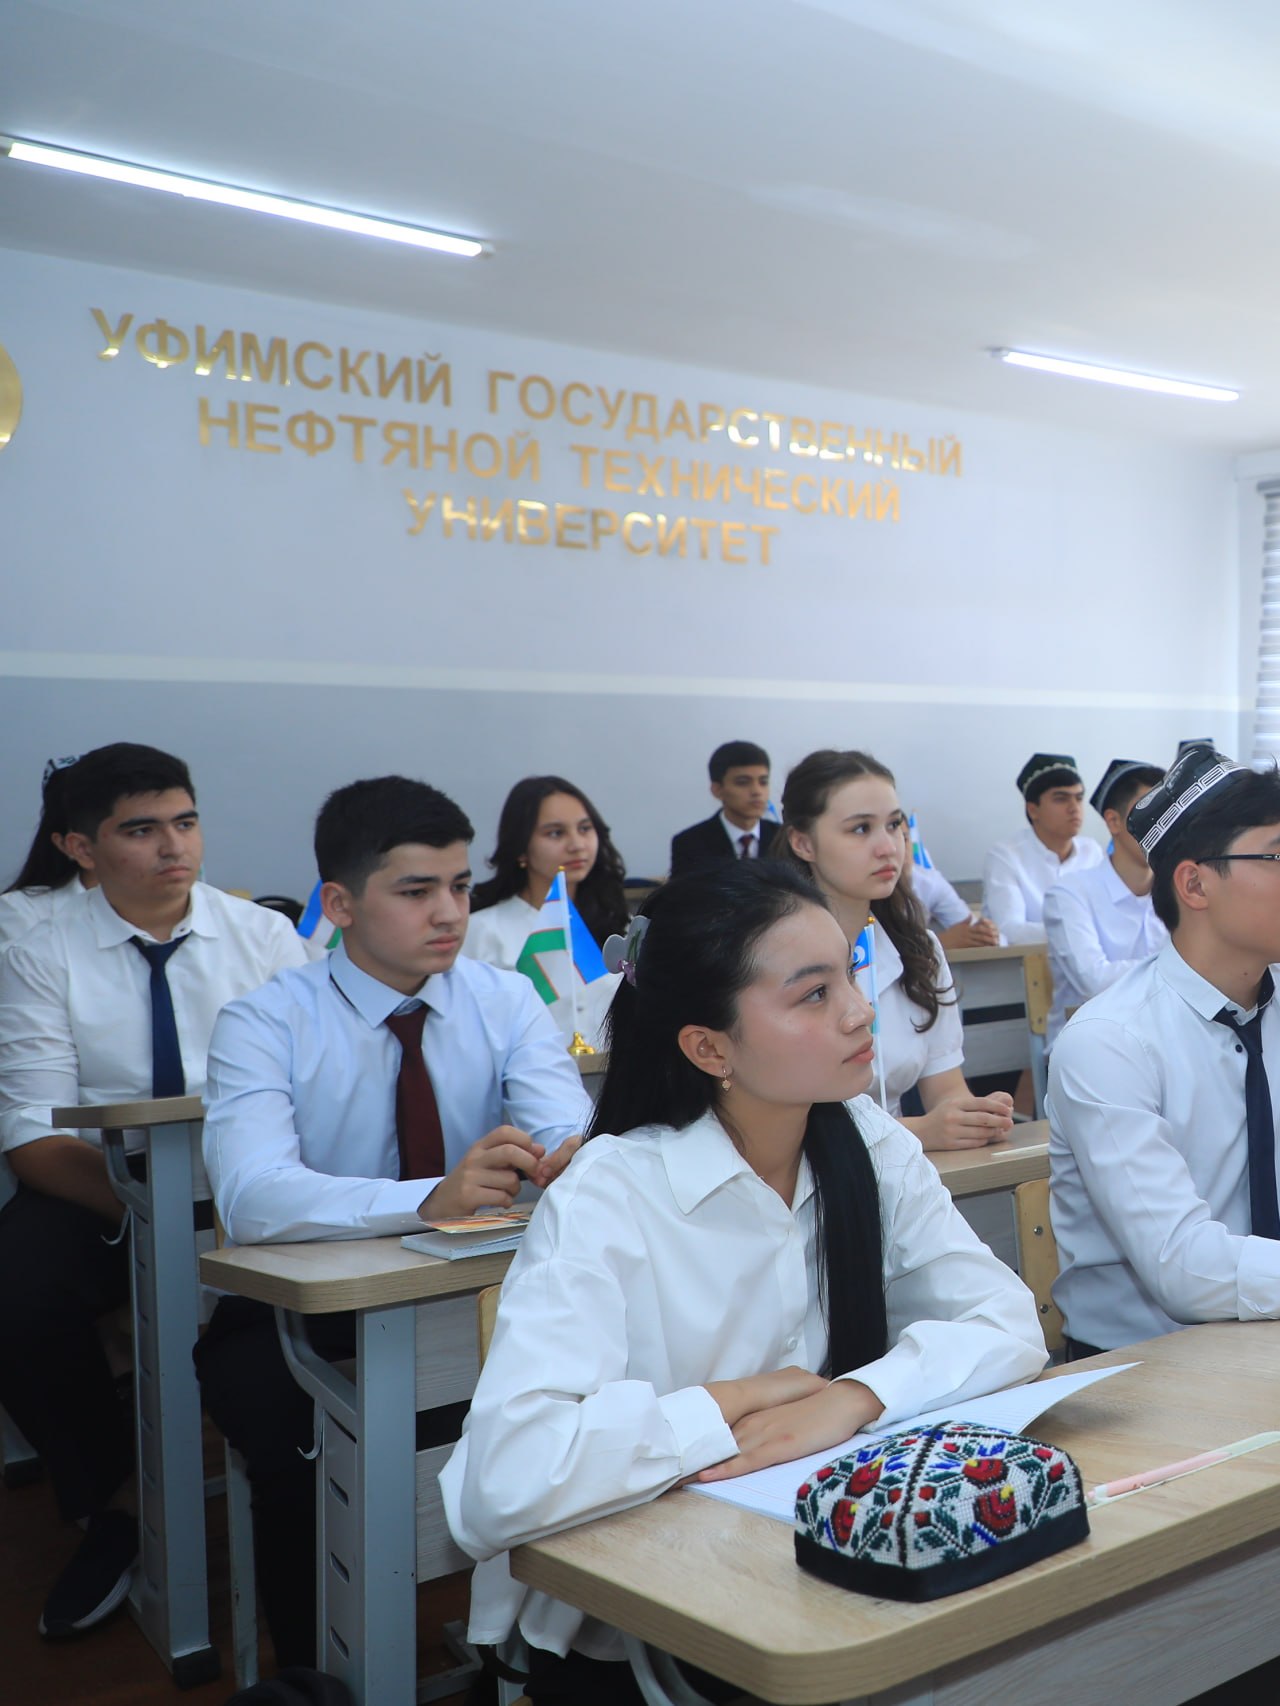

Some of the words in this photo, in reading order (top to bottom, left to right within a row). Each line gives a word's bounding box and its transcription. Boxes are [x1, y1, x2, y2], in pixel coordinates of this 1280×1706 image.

[90, 307, 451, 407] УФИМСКИЙ
[487, 369, 963, 478] ГОСУДАРСТВЕННЫЙ
[198, 397, 541, 483] НЕФТЯНОЙ
[569, 443, 902, 523] ТЕХНИЧЕСКИЙ
[402, 488, 780, 566] УНИВЕРСИТЕТ
